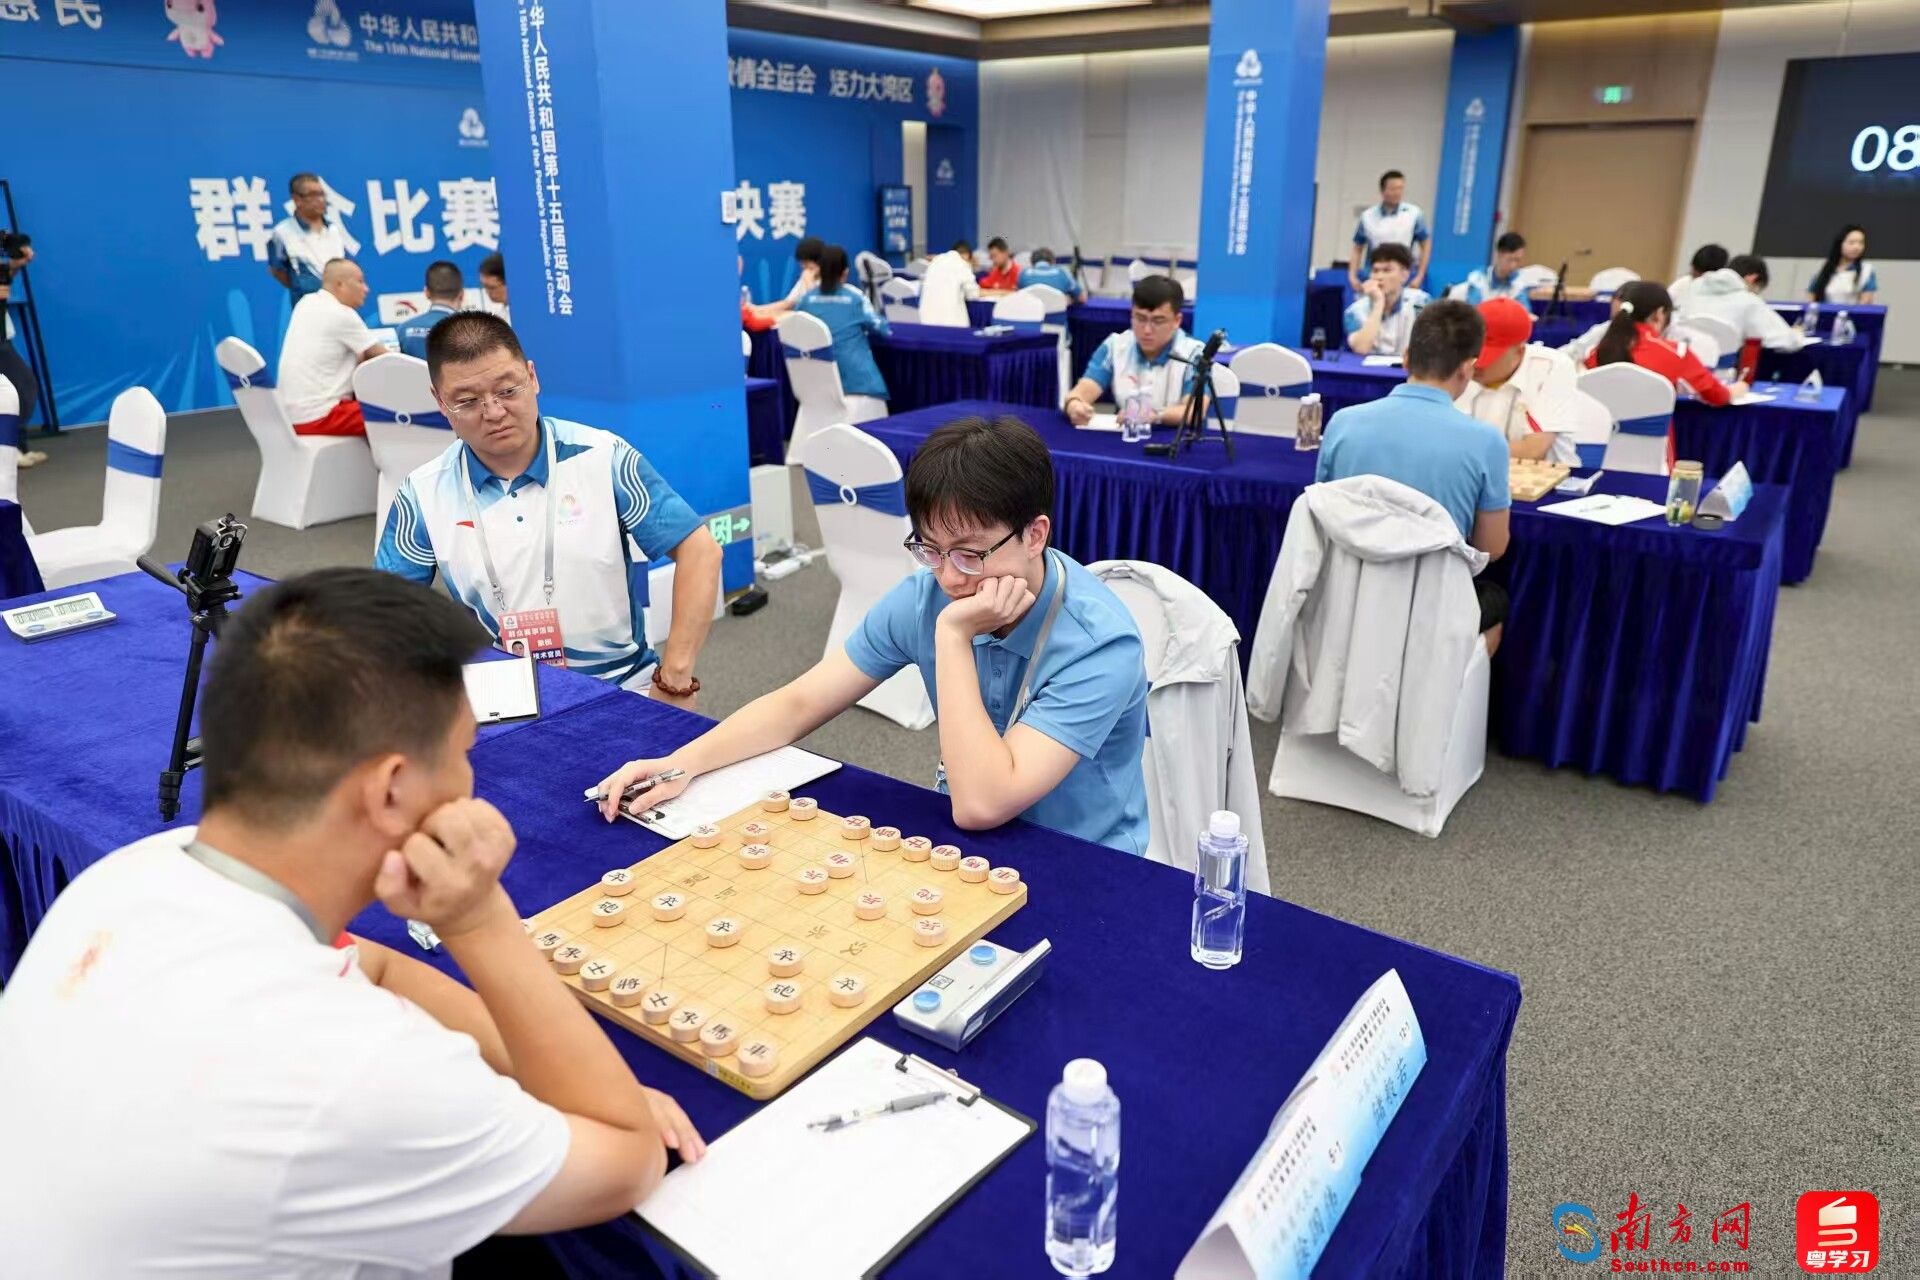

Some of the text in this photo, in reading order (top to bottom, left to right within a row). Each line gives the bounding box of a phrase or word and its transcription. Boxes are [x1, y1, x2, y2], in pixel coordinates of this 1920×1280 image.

[359, 11, 478, 45] 中华人民共和
[521, 37, 534, 89] National
[829, 69, 913, 102] 活力大湾区
[527, 90, 537, 132] Games
[529, 0, 573, 316] 华人民共和国第十五届运动会
[1851, 124, 1920, 172] 08
[540, 219, 551, 267] Republic
[546, 281, 556, 314] China
